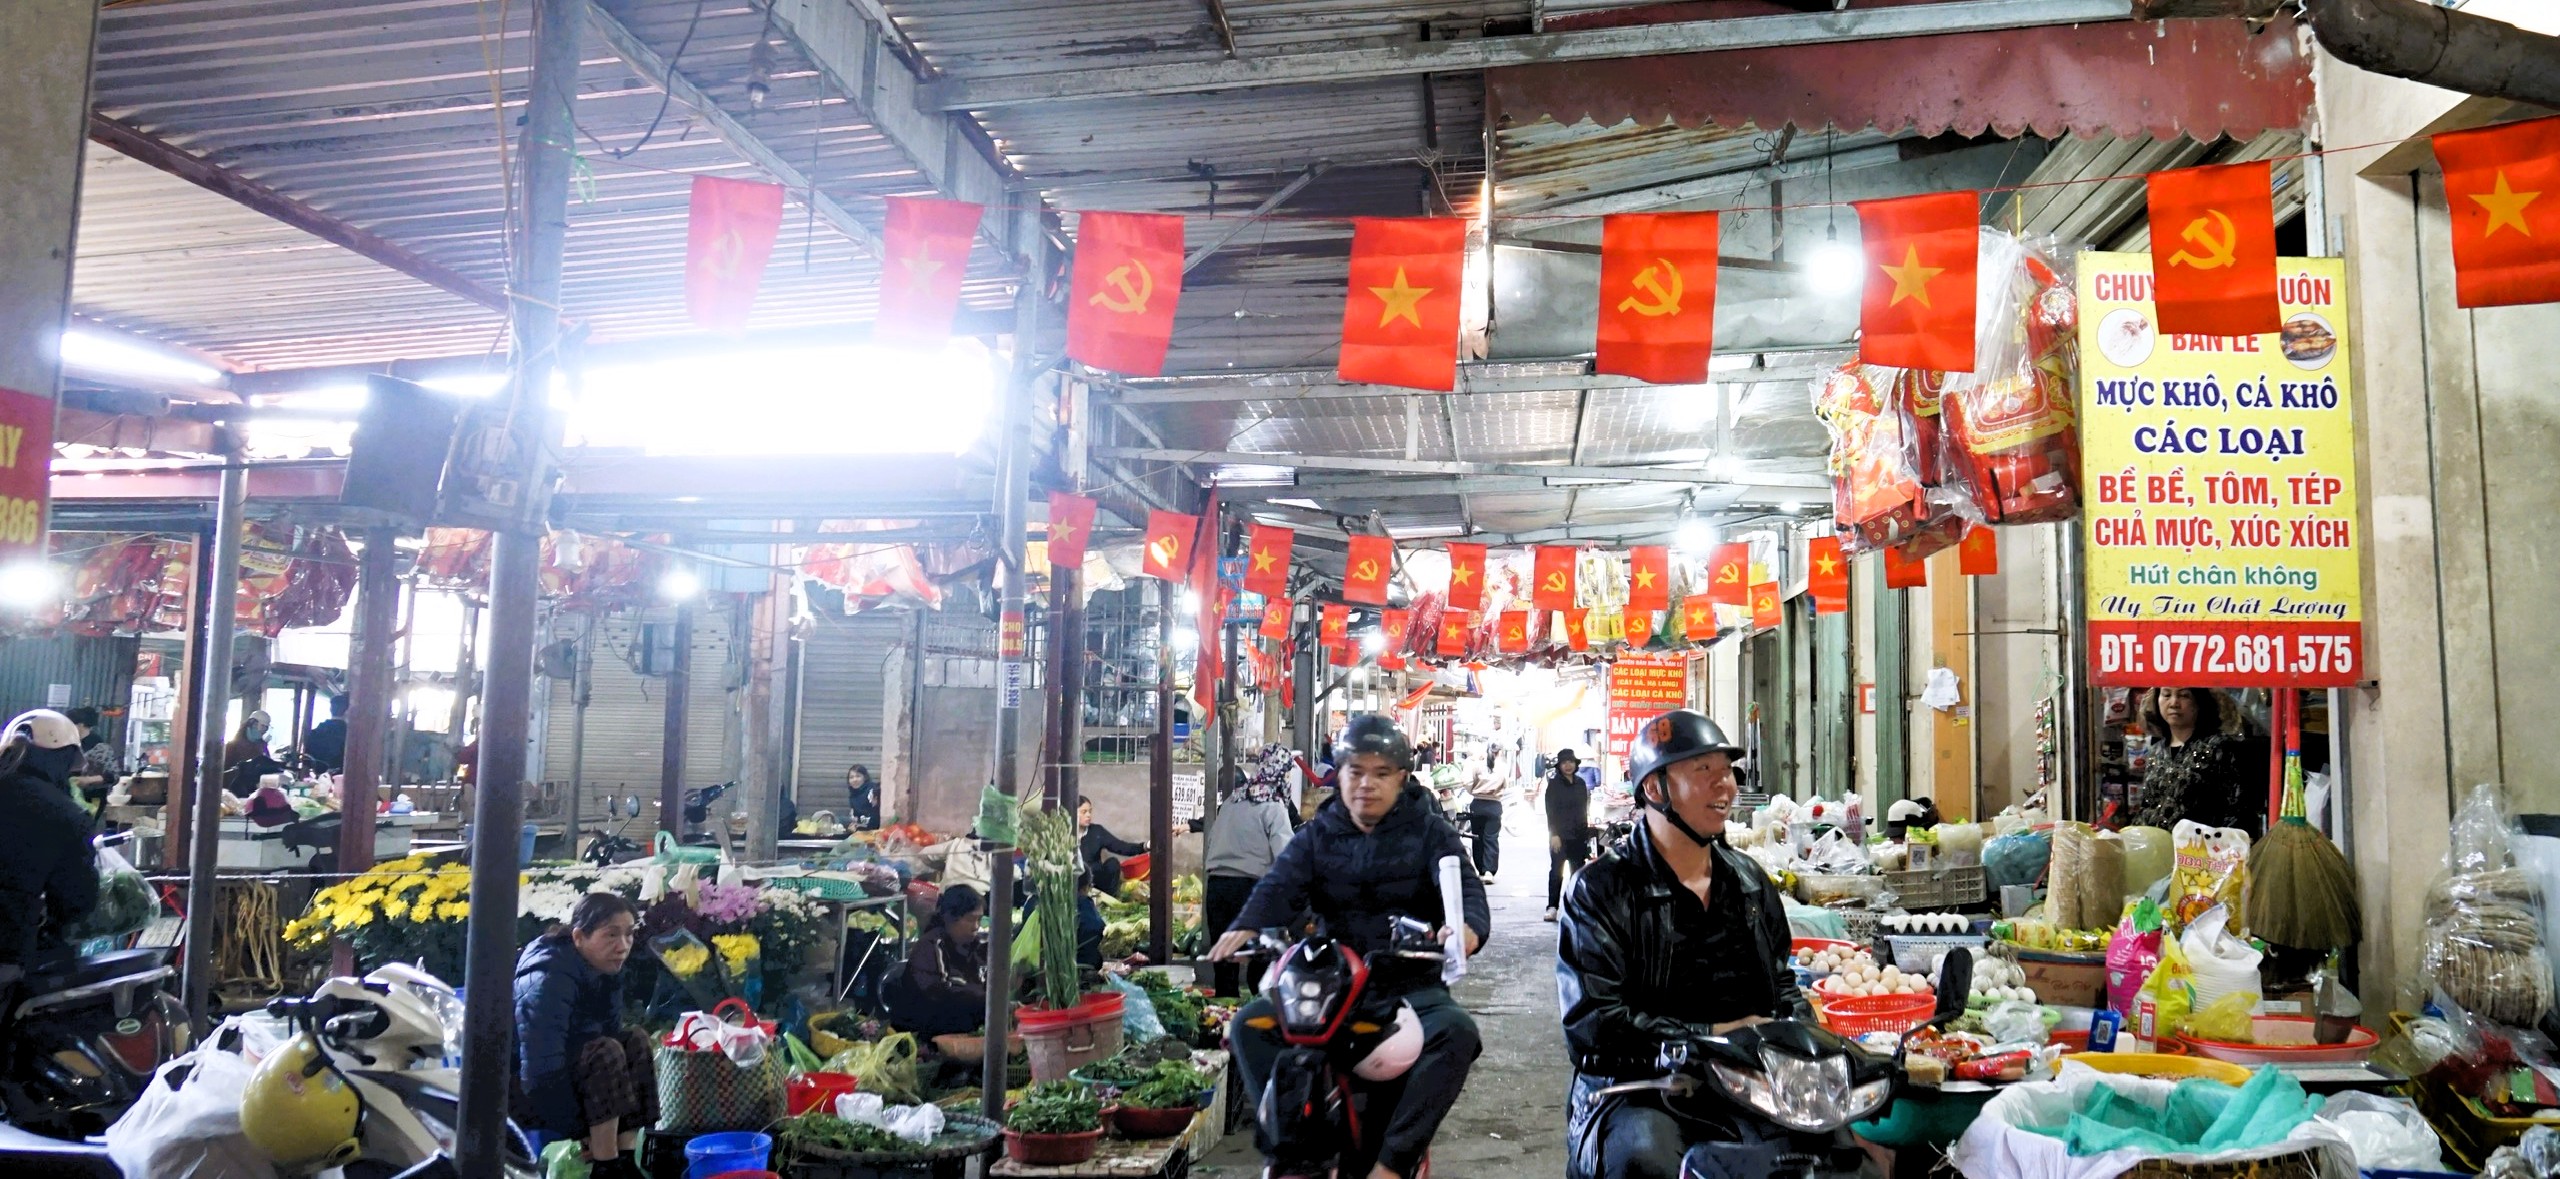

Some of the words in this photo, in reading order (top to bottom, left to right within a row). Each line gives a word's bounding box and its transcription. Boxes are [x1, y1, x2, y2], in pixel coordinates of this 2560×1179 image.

[2095, 273, 2155, 301] CHUY
[2281, 272, 2330, 305] UÔN
[2097, 376, 2155, 413] MỰC
[2163, 374, 2228, 412] KHÔ,
[2236, 375, 2273, 408] CÁ
[2280, 376, 2338, 409] KHÔ
[2134, 421, 2208, 454] CÁC
[2219, 427, 2305, 461] LOẠI
[2099, 466, 2137, 503] BỀ
[2147, 466, 2195, 507] BỀ,
[2204, 472, 2278, 508] TÔM,
[2287, 471, 2341, 506] TÉP
[2095, 510, 2145, 547] CHẢ
[2156, 516, 2221, 552] MỰC,
[2230, 515, 2280, 548] XÚC
[2289, 515, 2350, 548] XÍCH
[2131, 564, 2169, 585] Hút
[2178, 565, 2236, 585] chân
[2245, 564, 2318, 590] không
[2100, 596, 2140, 619] Uy
[2150, 596, 2197, 615] Tín
[2206, 594, 2261, 615] Chất
[2268, 596, 2347, 620] Lượng
[2100, 634, 2144, 673] ĐT:
[2152, 635, 2353, 674] 0772.681.575
[1613, 667, 1628, 676] CÁC
[1631, 668, 1647, 678] LOẠI
[1612, 688, 1629, 697] CÁC
[1631, 689, 1650, 699] LOẠI
[1611, 712, 1635, 735] BÁN
